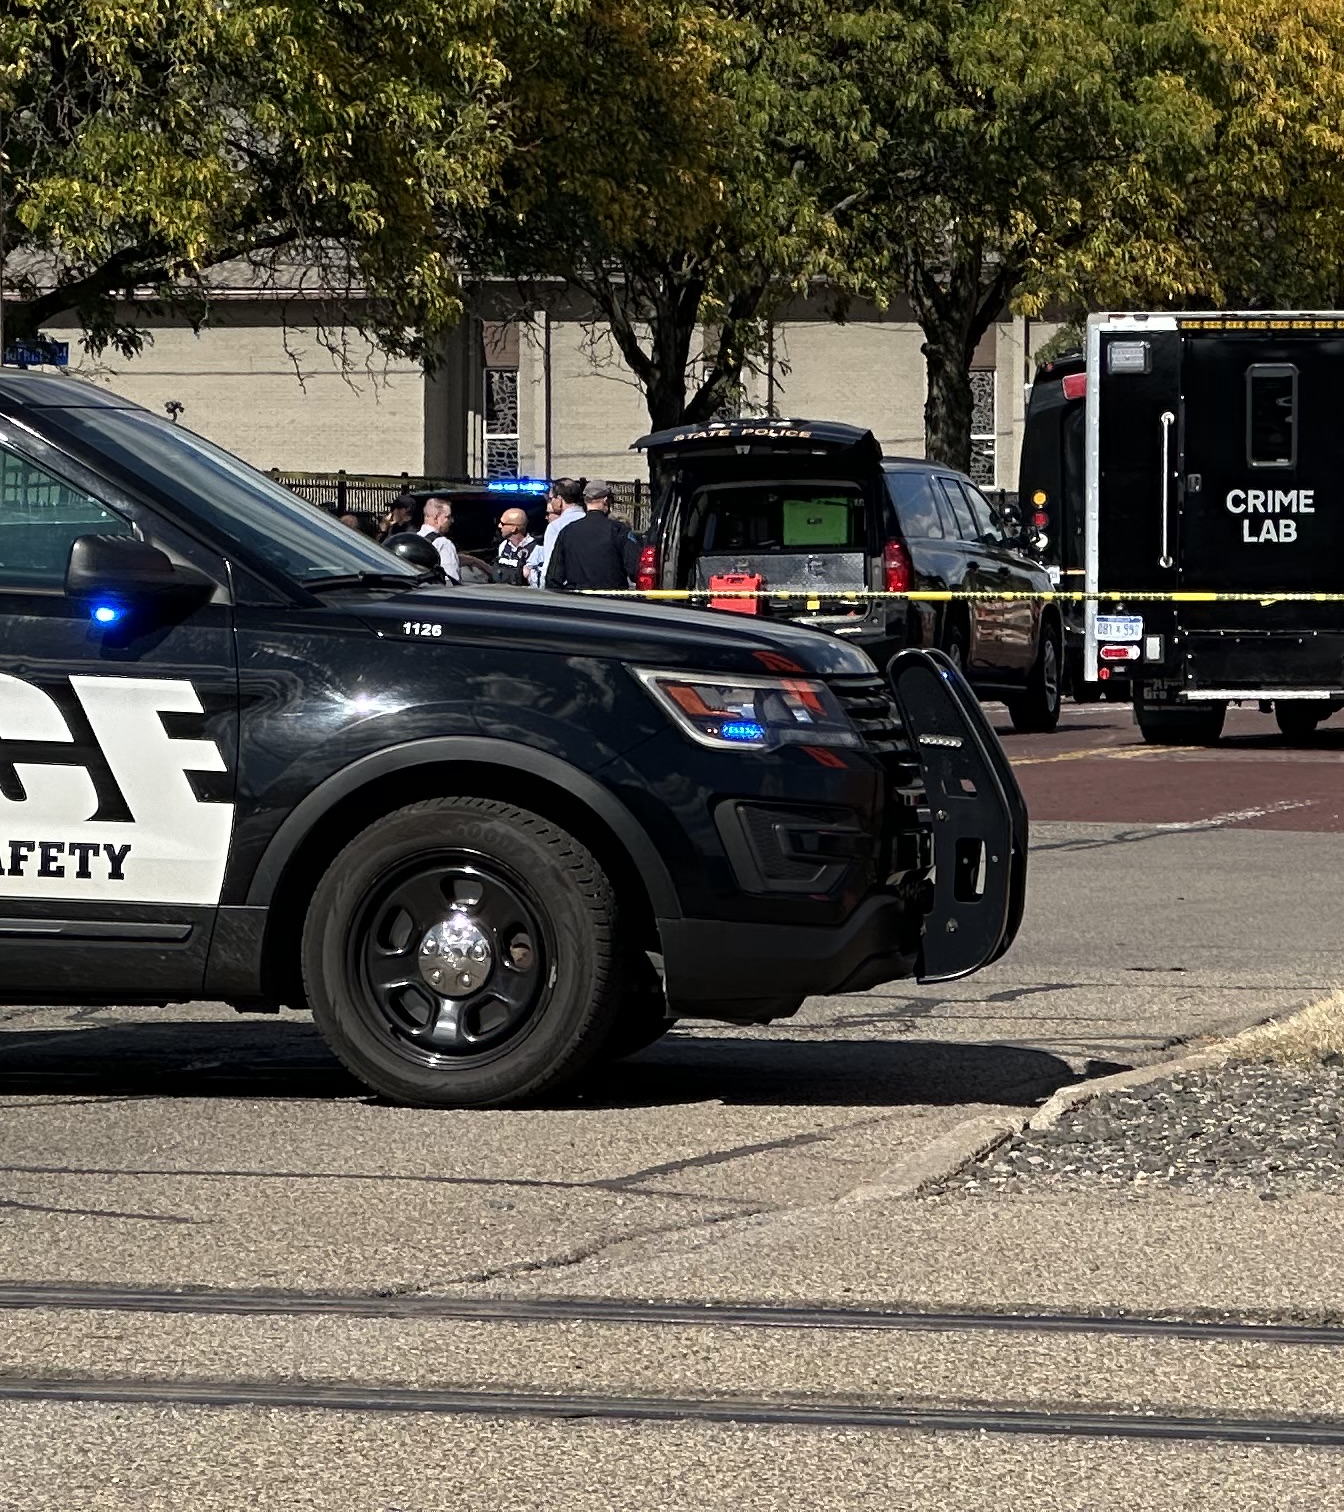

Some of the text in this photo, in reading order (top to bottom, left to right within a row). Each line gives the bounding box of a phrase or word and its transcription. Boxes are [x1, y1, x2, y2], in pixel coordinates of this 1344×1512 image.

[673, 427, 812, 442] STATE POLICE
[1226, 489, 1316, 514] CRIME
[1243, 519, 1298, 543] LAB
[402, 622, 442, 637] 1126
